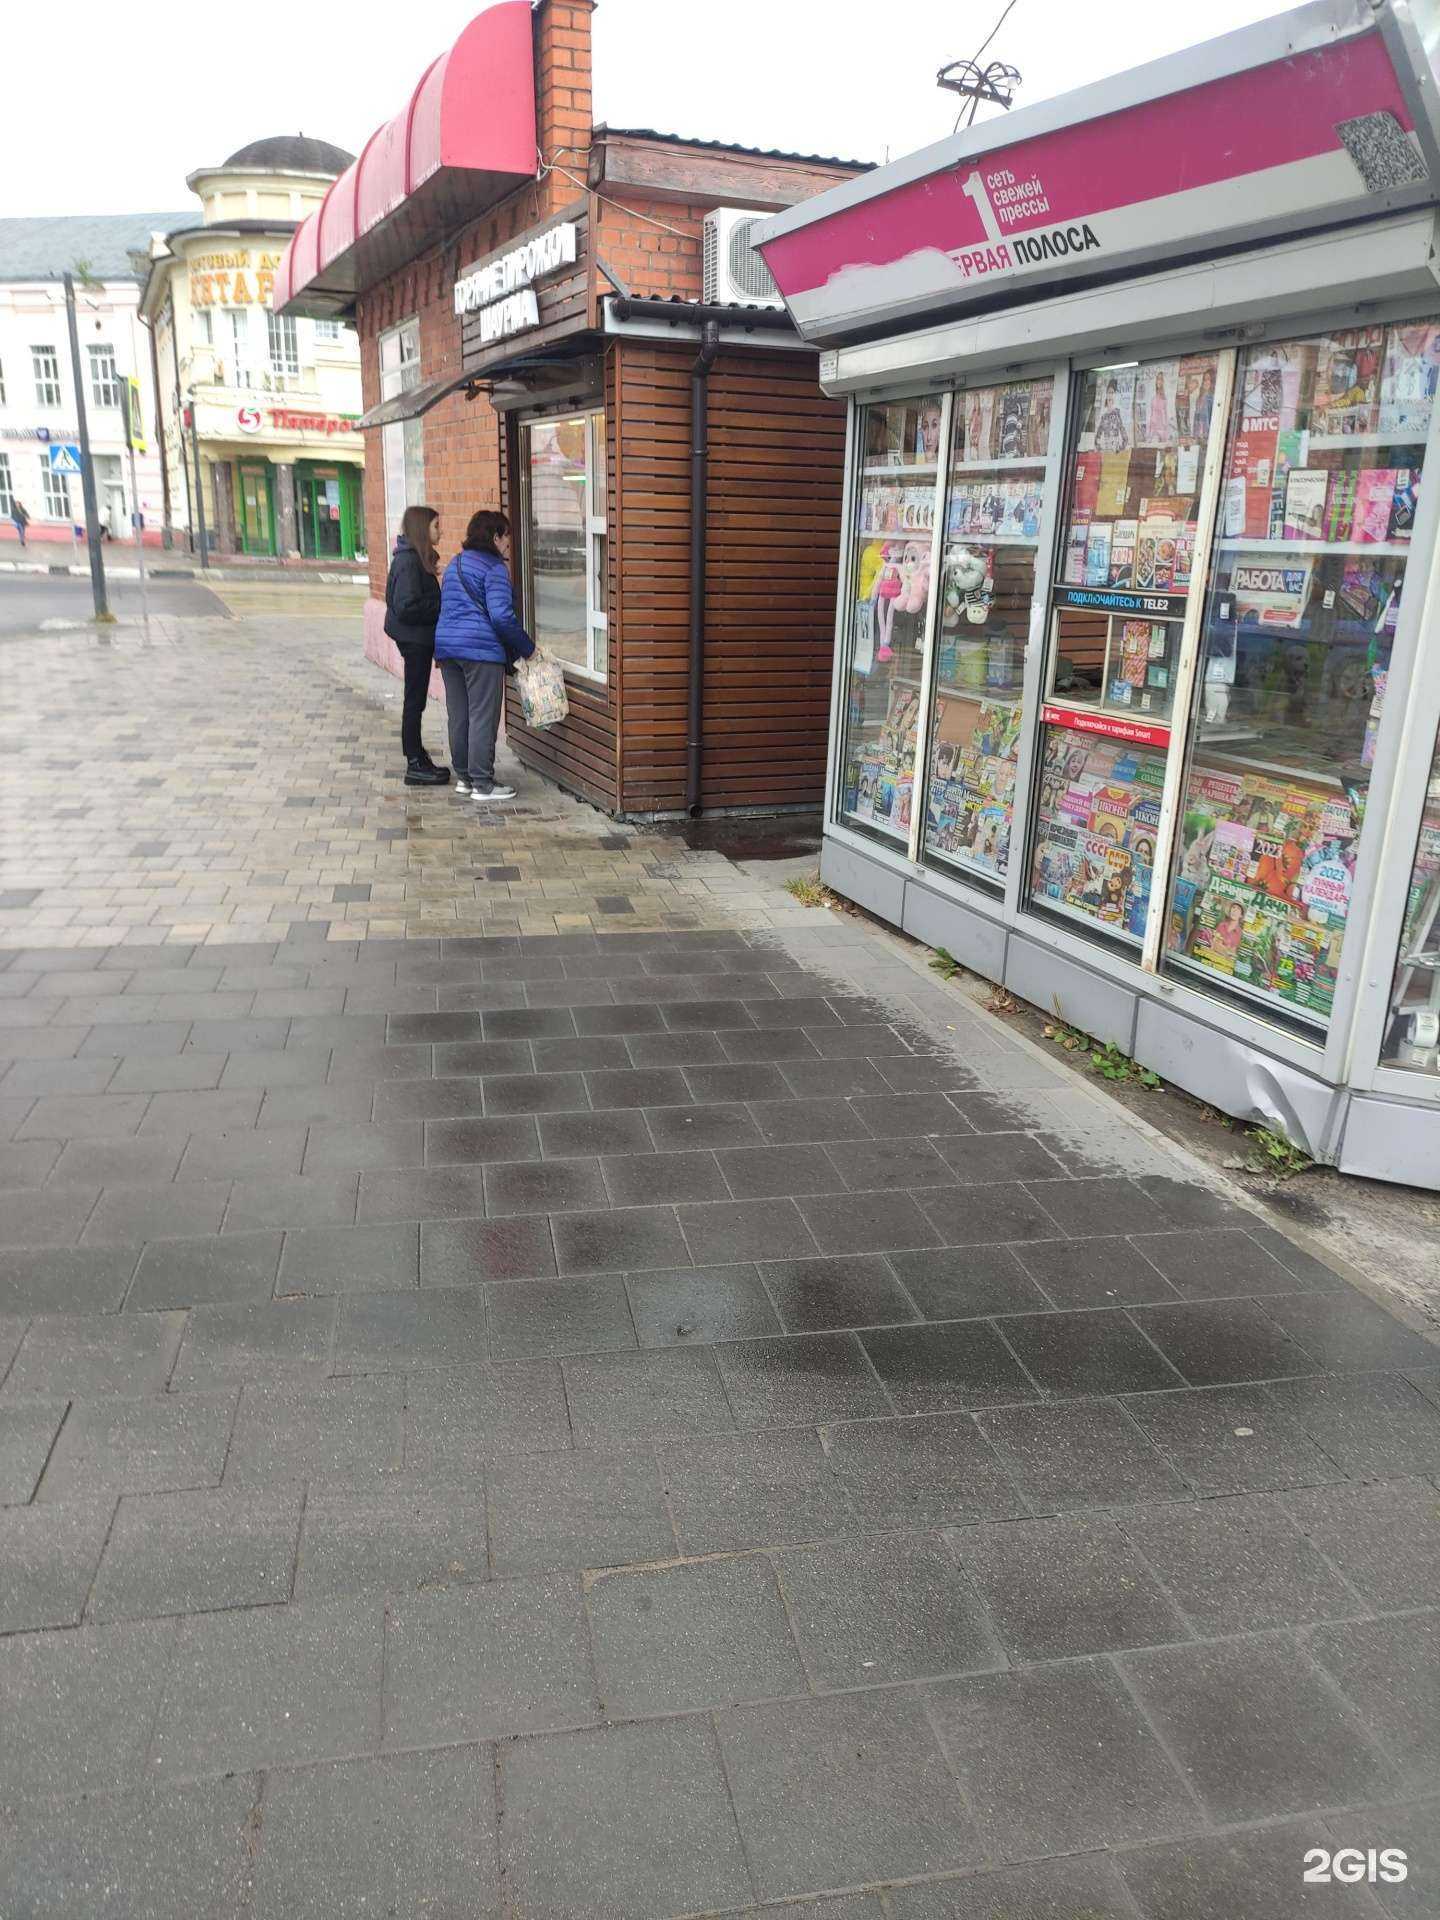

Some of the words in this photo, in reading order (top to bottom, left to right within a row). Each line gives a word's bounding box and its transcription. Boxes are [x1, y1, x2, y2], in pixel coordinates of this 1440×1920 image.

[987, 169, 1016, 190] сеть
[993, 174, 1043, 206] свежей
[999, 197, 1050, 226] прессы
[952, 244, 1013, 278] РВАЯ
[1012, 224, 1101, 265] ПОЛОСА
[267, 407, 353, 437] Пятеро
[1250, 416, 1279, 432] МТС
[1237, 569, 1285, 592] РАБОТА
[1067, 591, 1135, 608] ПОДКЛЮЧАЙТЕСЬ
[1143, 598, 1169, 611] TELE2
[1135, 727, 1152, 740] Smart
[1099, 799, 1128, 818] ИКОНЫ
[1134, 808, 1161, 827] ИКОН
[1255, 839, 1284, 858] 2023
[1319, 865, 1346, 881] 2023
